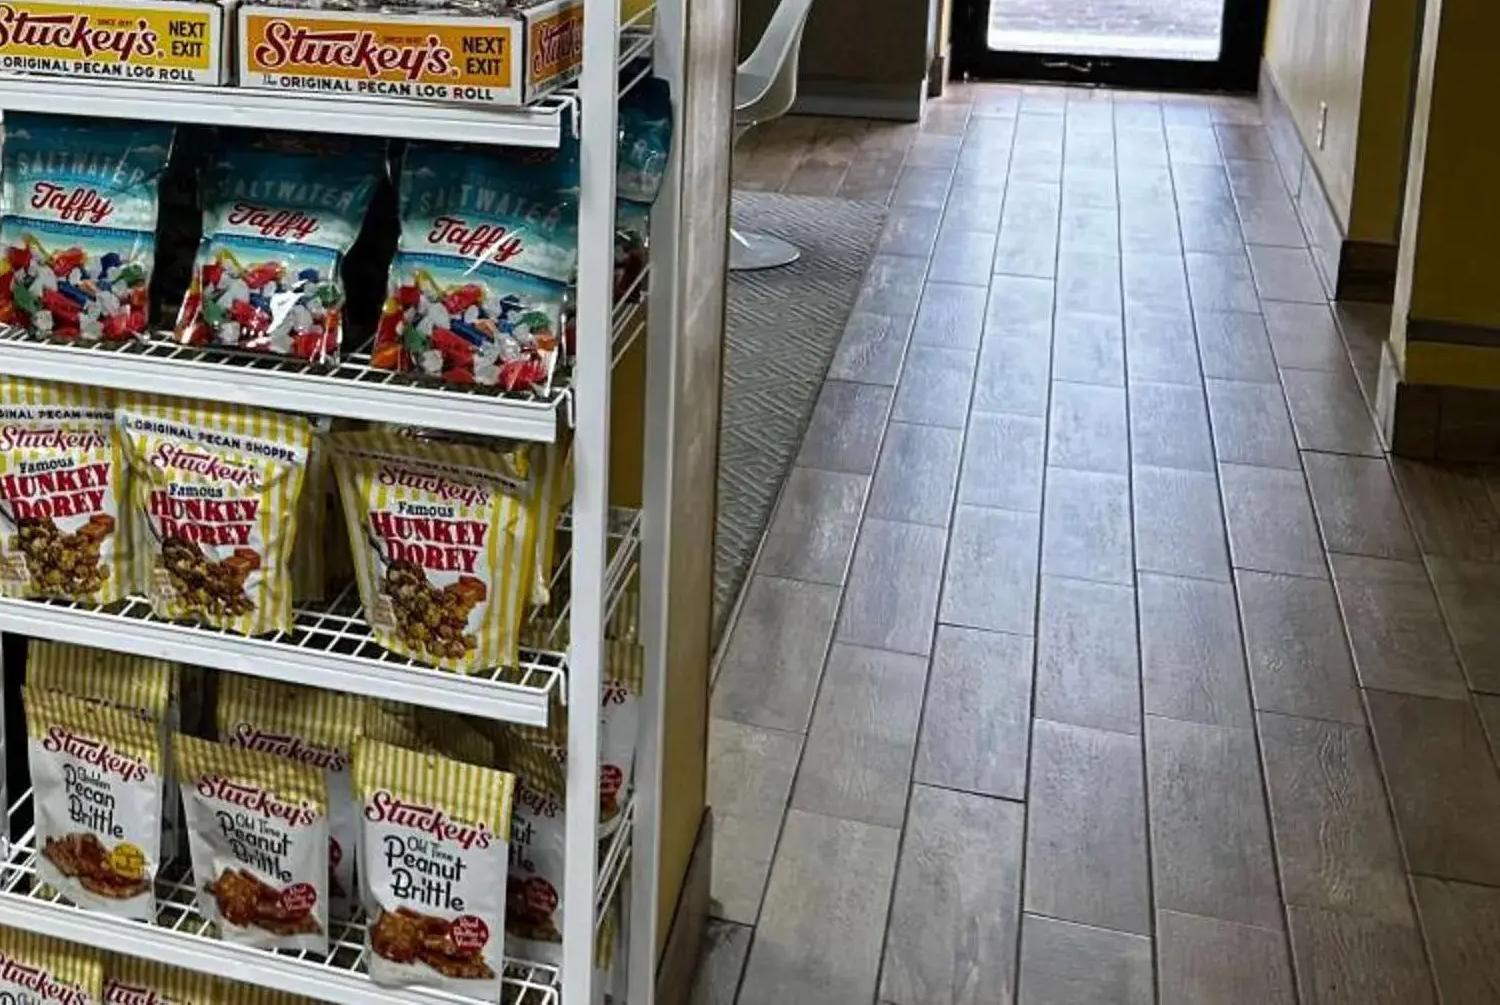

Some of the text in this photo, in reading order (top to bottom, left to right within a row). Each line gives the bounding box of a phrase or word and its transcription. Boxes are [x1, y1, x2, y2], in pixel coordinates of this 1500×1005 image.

[169, 20, 206, 38] NEXT
[462, 36, 505, 55] NEXT
[171, 40, 204, 58] EXIT
[254, 18, 452, 81] Stuckey's
[466, 57, 502, 76] EXIT
[3, 55, 69, 72] ORIGINAL
[74, 62, 122, 76] PECAN
[126, 66, 155, 79] LOG
[159, 68, 195, 82] ROLL
[280, 75, 352, 92] ORIGINAL
[358, 81, 411, 96] PECAN
[416, 85, 447, 98] LOG
[453, 87, 494, 101] ROLL
[30, 181, 115, 224] Taffy
[228, 202, 320, 239] Taffy
[428, 216, 524, 262] Taffy
[134, 419, 194, 439] ORIGINAL
[151, 442, 262, 486] Stuckey's
[10, 488, 105, 520] DOREY
[378, 464, 491, 507] Stuckey's
[151, 490, 260, 523] HUNKEY
[161, 516, 253, 546] DOREY
[369, 510, 489, 548] HUNKEY
[385, 537, 479, 574] DOREY
[43, 726, 149, 782] Stuckey's
[63, 763, 115, 809] Pecan
[197, 774, 316, 827] Stuckey's
[68, 794, 124, 839] Brittle
[215, 810, 293, 857] Peanut
[364, 790, 493, 850] Stuckey's
[383, 834, 467, 882] Peanut
[407, 835, 429, 854] Old
[390, 867, 466, 912] Brittle
